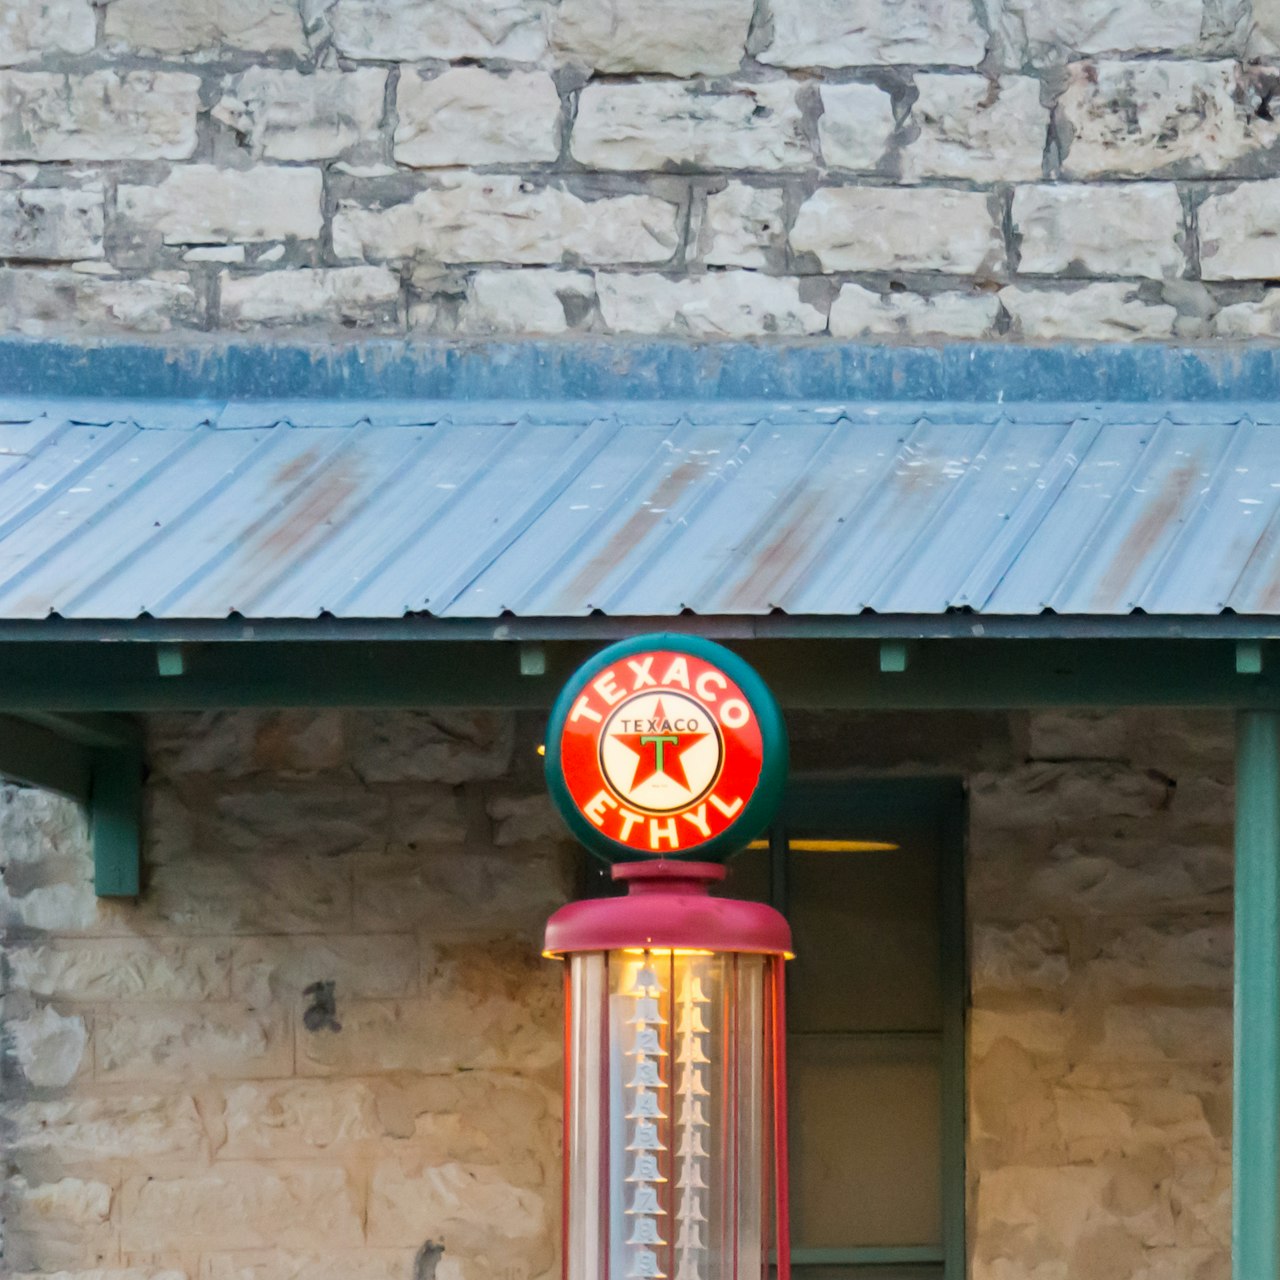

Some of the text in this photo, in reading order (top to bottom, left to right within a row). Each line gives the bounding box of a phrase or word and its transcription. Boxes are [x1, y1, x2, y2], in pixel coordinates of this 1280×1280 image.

[570, 656, 750, 729] TEXACO
[620, 717, 699, 733] TEXACO
[583, 788, 743, 849] ETHYL
